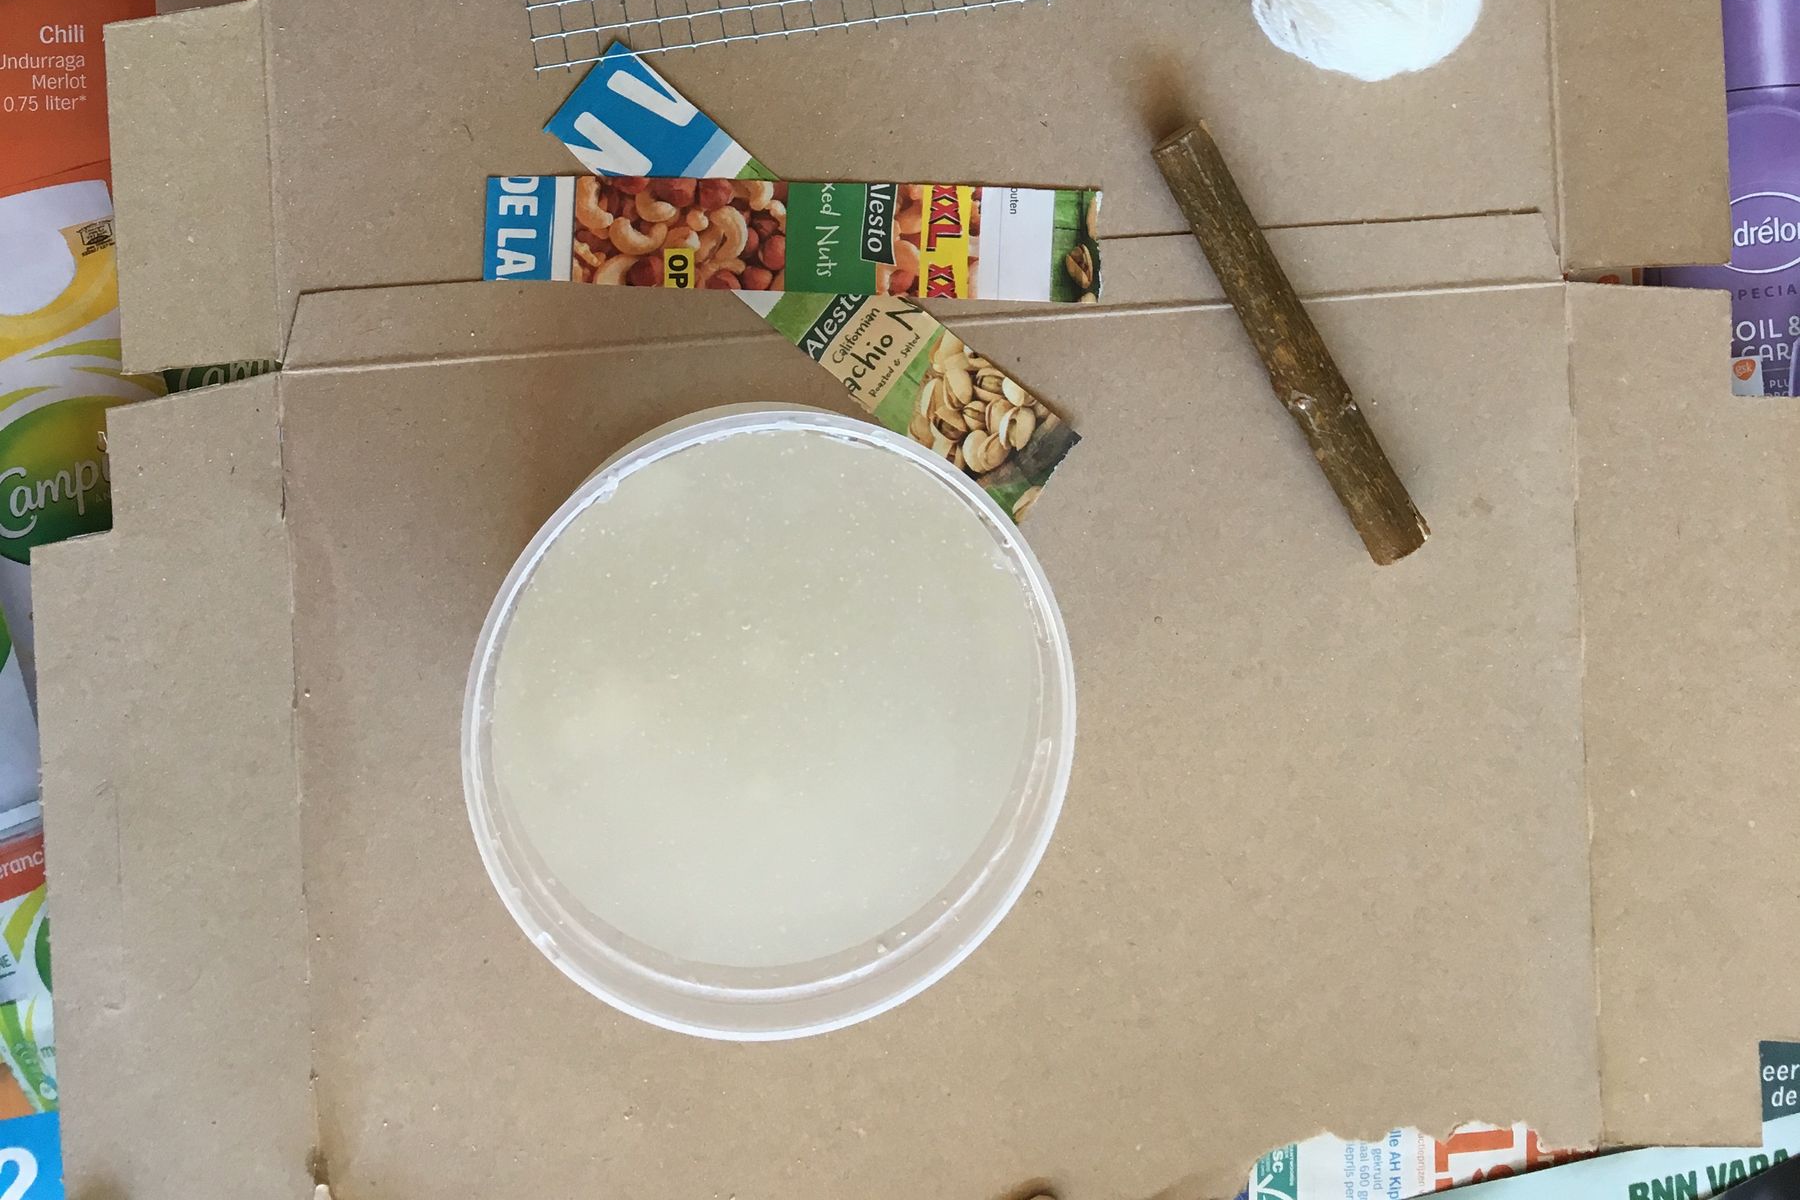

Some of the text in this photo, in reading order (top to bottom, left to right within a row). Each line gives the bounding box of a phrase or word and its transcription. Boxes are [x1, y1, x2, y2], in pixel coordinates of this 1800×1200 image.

[40, 24, 84, 44] Chili
[32, 73, 87, 90] Merlot
[3, 96, 39, 112] 0.75
[815, 225, 841, 278] Nuts
[832, 307, 881, 364] Californian
[1735, 318, 1783, 342] OIL
[1771, 1086, 1797, 1107] de
[1389, 1152, 1402, 1172] AH
